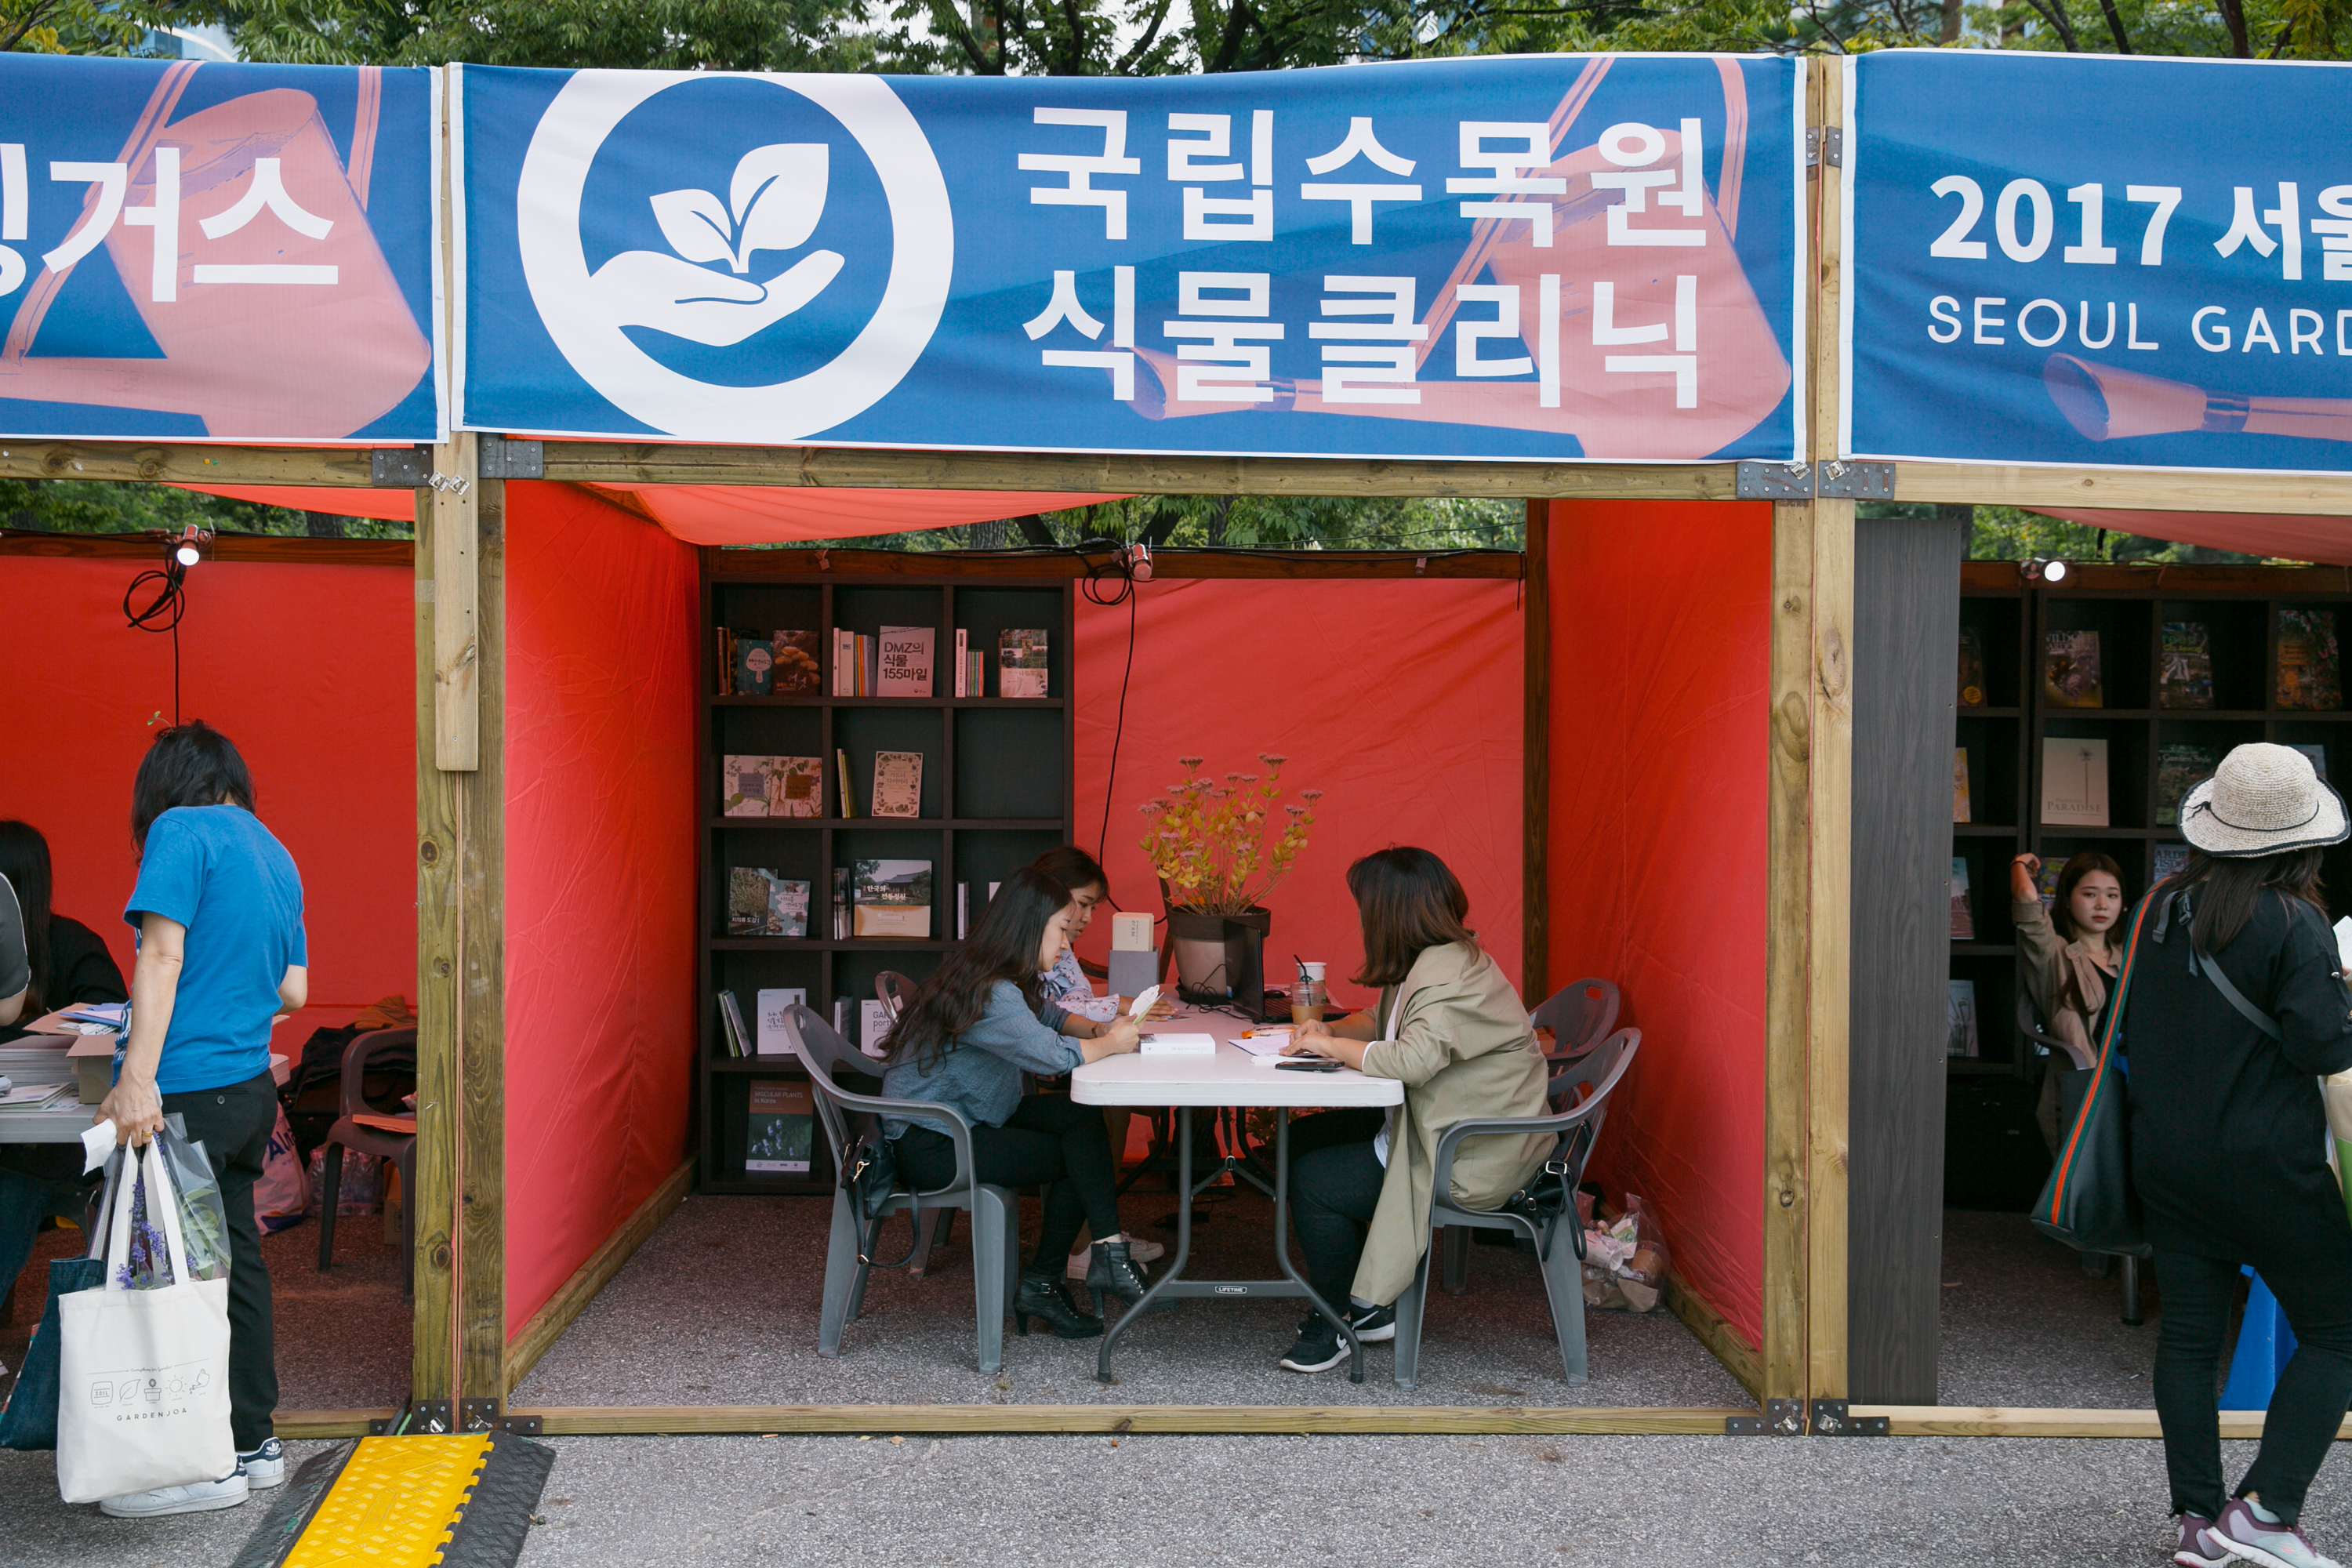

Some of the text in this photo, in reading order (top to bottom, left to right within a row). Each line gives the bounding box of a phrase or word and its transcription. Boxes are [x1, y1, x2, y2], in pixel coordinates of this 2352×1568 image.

[1018, 107, 1707, 248] 국립수목원
[0, 143, 339, 303] 거스
[1929, 175, 2183, 266] 2017
[1022, 266, 1697, 408] 식물클리닉
[1927, 295, 2159, 350] SEOUL
[884, 641, 924, 655] DMZ의
[884, 654, 908, 667] 식물
[883, 667, 927, 681] 155마일
[873, 1020, 892, 1033] port
[117, 1407, 187, 1421] GARDENJOA
